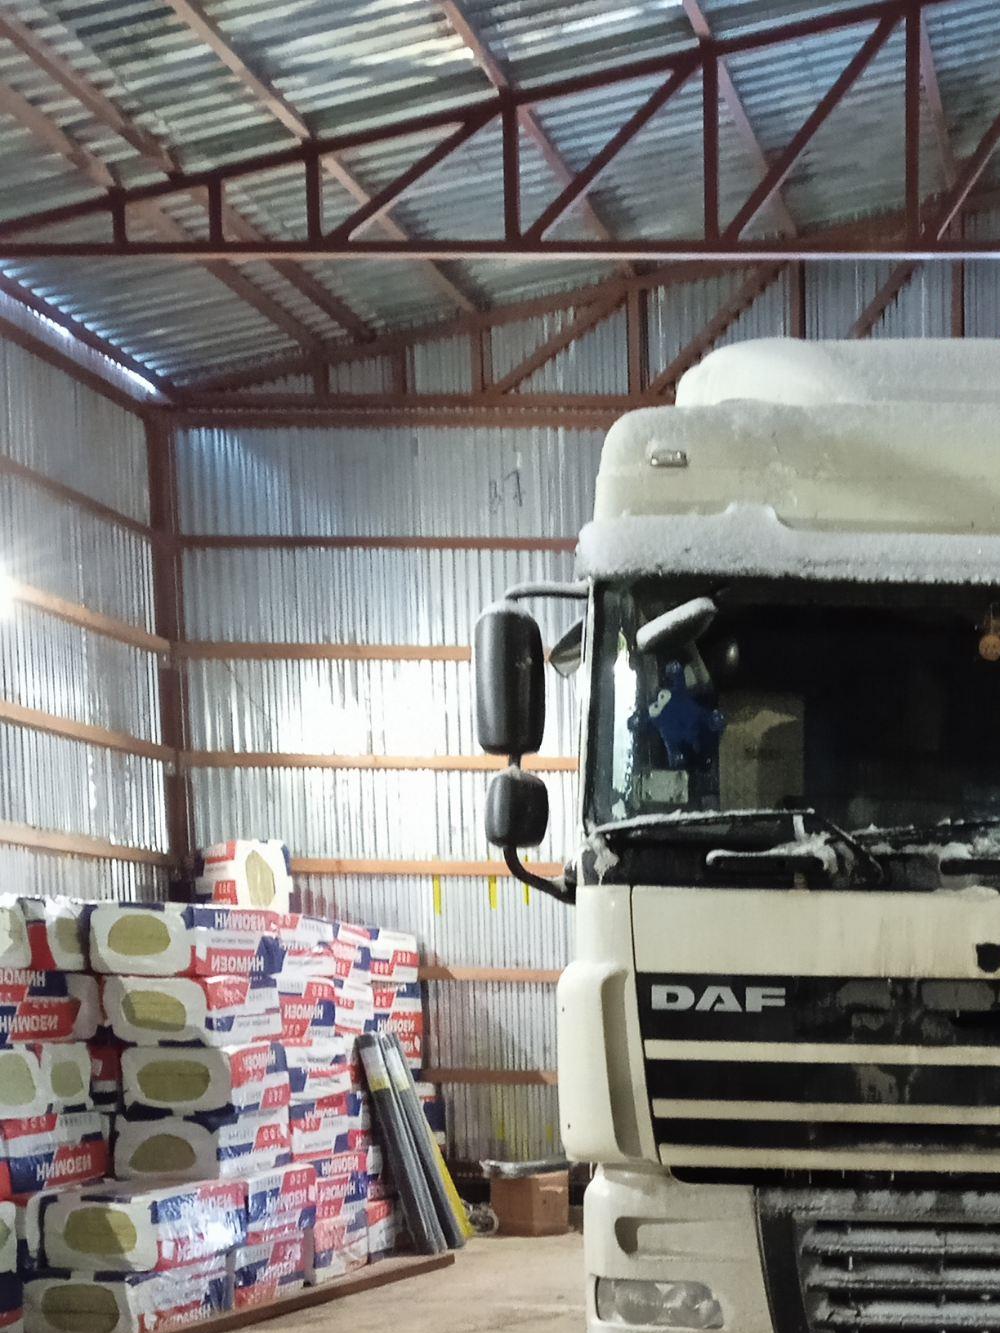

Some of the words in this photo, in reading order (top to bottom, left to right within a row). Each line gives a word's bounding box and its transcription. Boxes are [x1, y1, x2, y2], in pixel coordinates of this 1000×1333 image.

[211, 954, 265, 973] ИЗОМИН
[0, 968, 46, 988] ОМИН
[651, 984, 786, 1013] DAF
